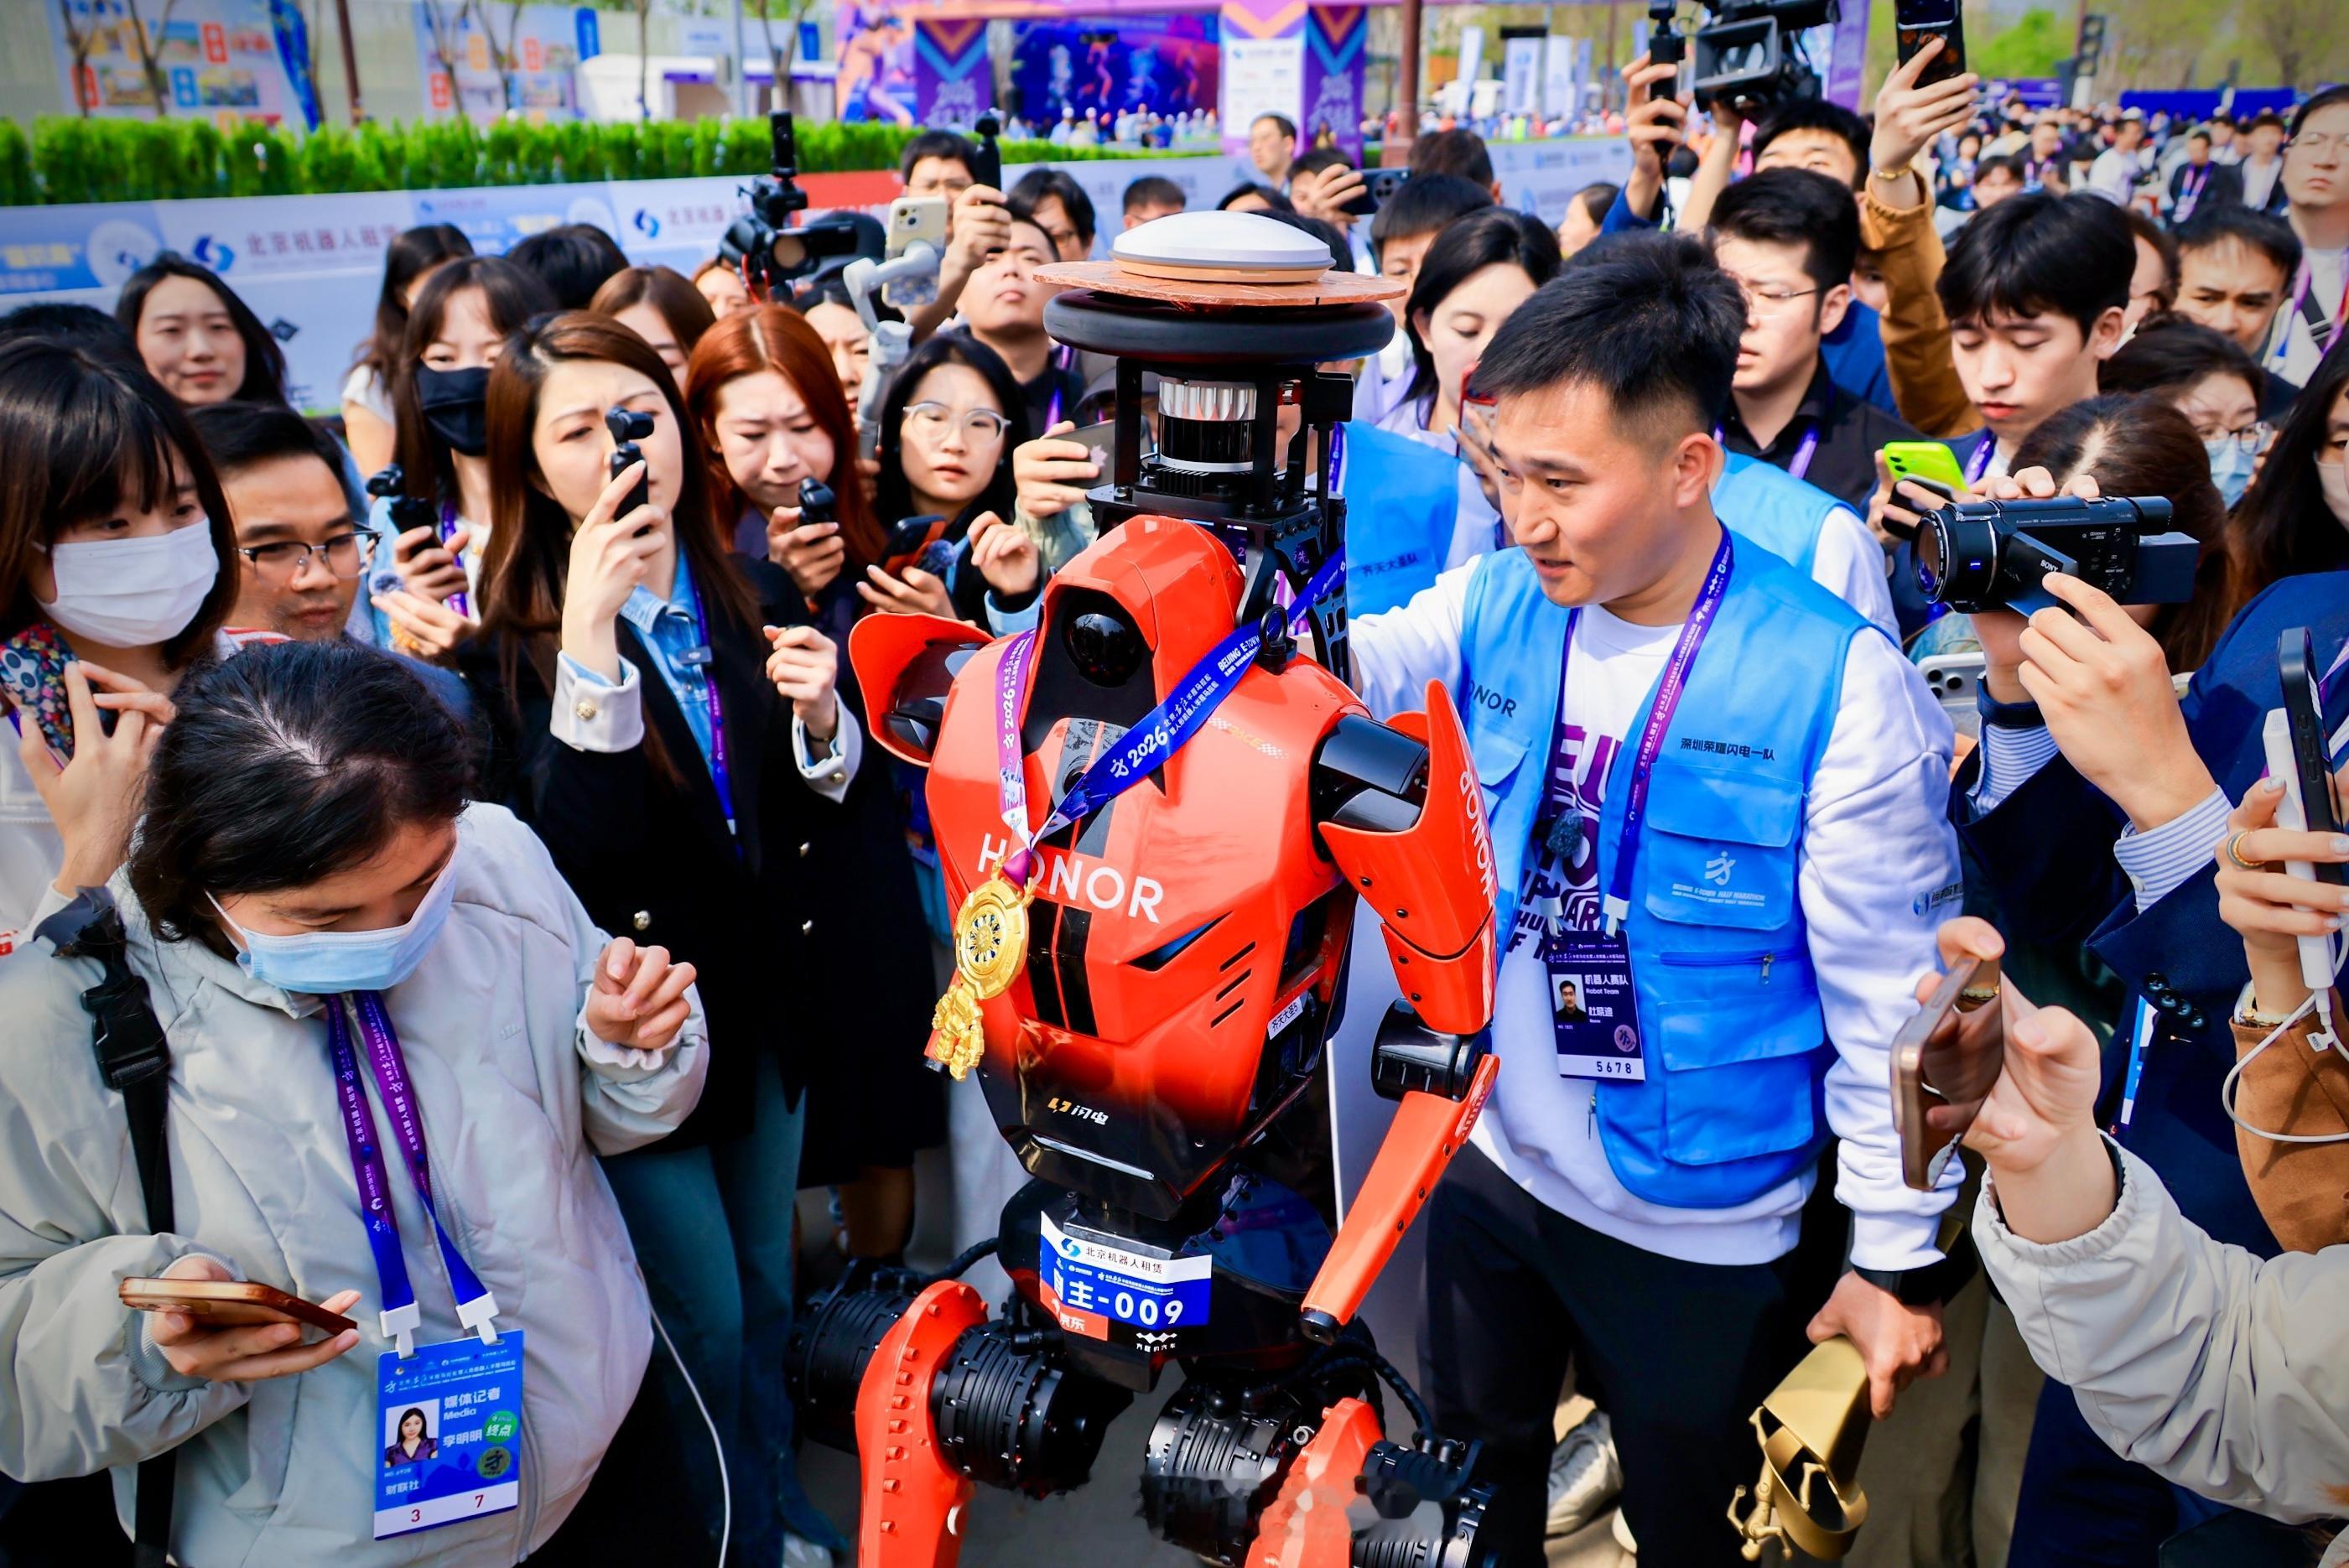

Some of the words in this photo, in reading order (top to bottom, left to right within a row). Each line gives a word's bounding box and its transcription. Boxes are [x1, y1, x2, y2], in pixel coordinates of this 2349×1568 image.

[2040, 559, 2058, 573] SONY
[1218, 648, 1241, 672] BEIJING
[1003, 688, 1016, 729] 2026
[1127, 725, 1168, 768] 2026
[1680, 738, 1775, 761] 深圳荣耀闪电一队
[1460, 771, 1494, 896] HONOR
[1086, 1247, 1162, 1274] 北京机器人租赁
[1060, 1311, 1085, 1332] 京东
[444, 1386, 502, 1410] 媒体记者
[443, 1407, 477, 1422] Media
[486, 1424, 512, 1437] 终点
[475, 1494, 484, 1508] 7
[411, 1508, 421, 1523] 3
